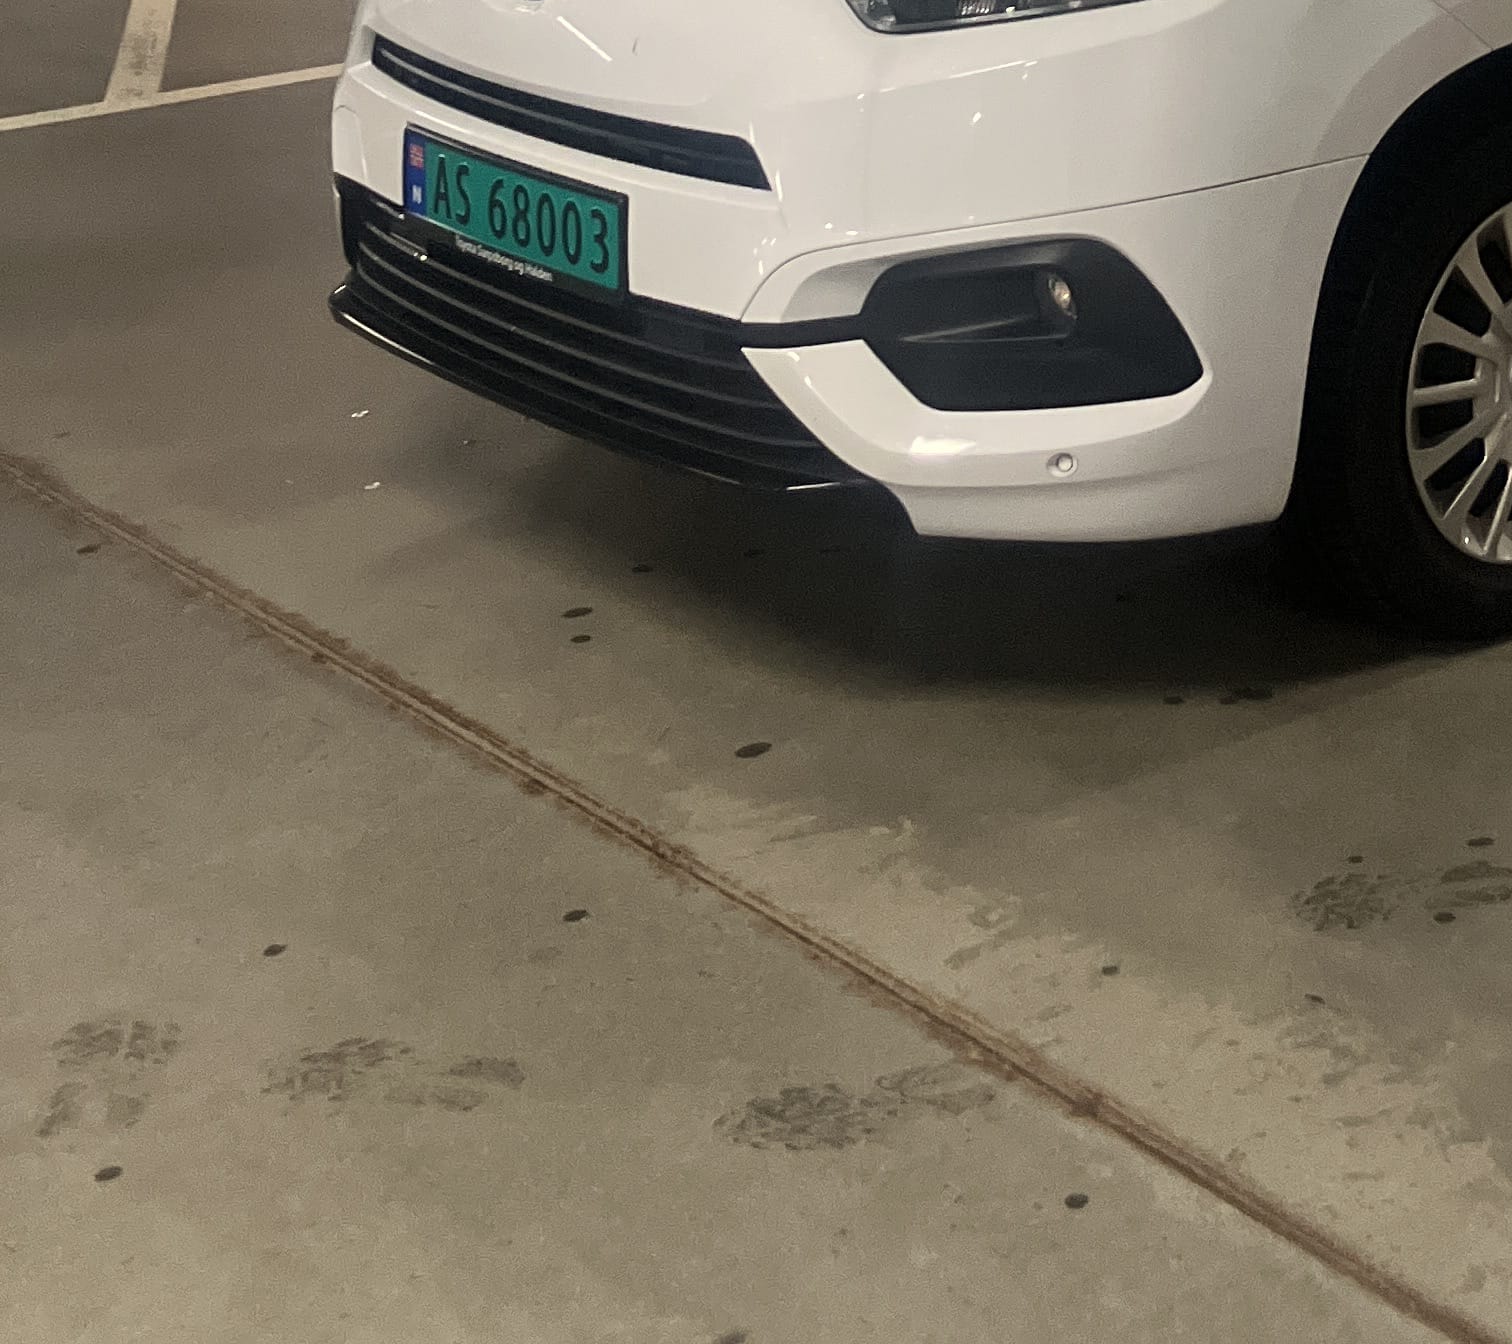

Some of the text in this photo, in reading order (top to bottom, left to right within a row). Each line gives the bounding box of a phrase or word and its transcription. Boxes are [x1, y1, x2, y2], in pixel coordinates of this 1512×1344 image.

[411, 184, 423, 204] N
[433, 153, 610, 274] AS 68003
